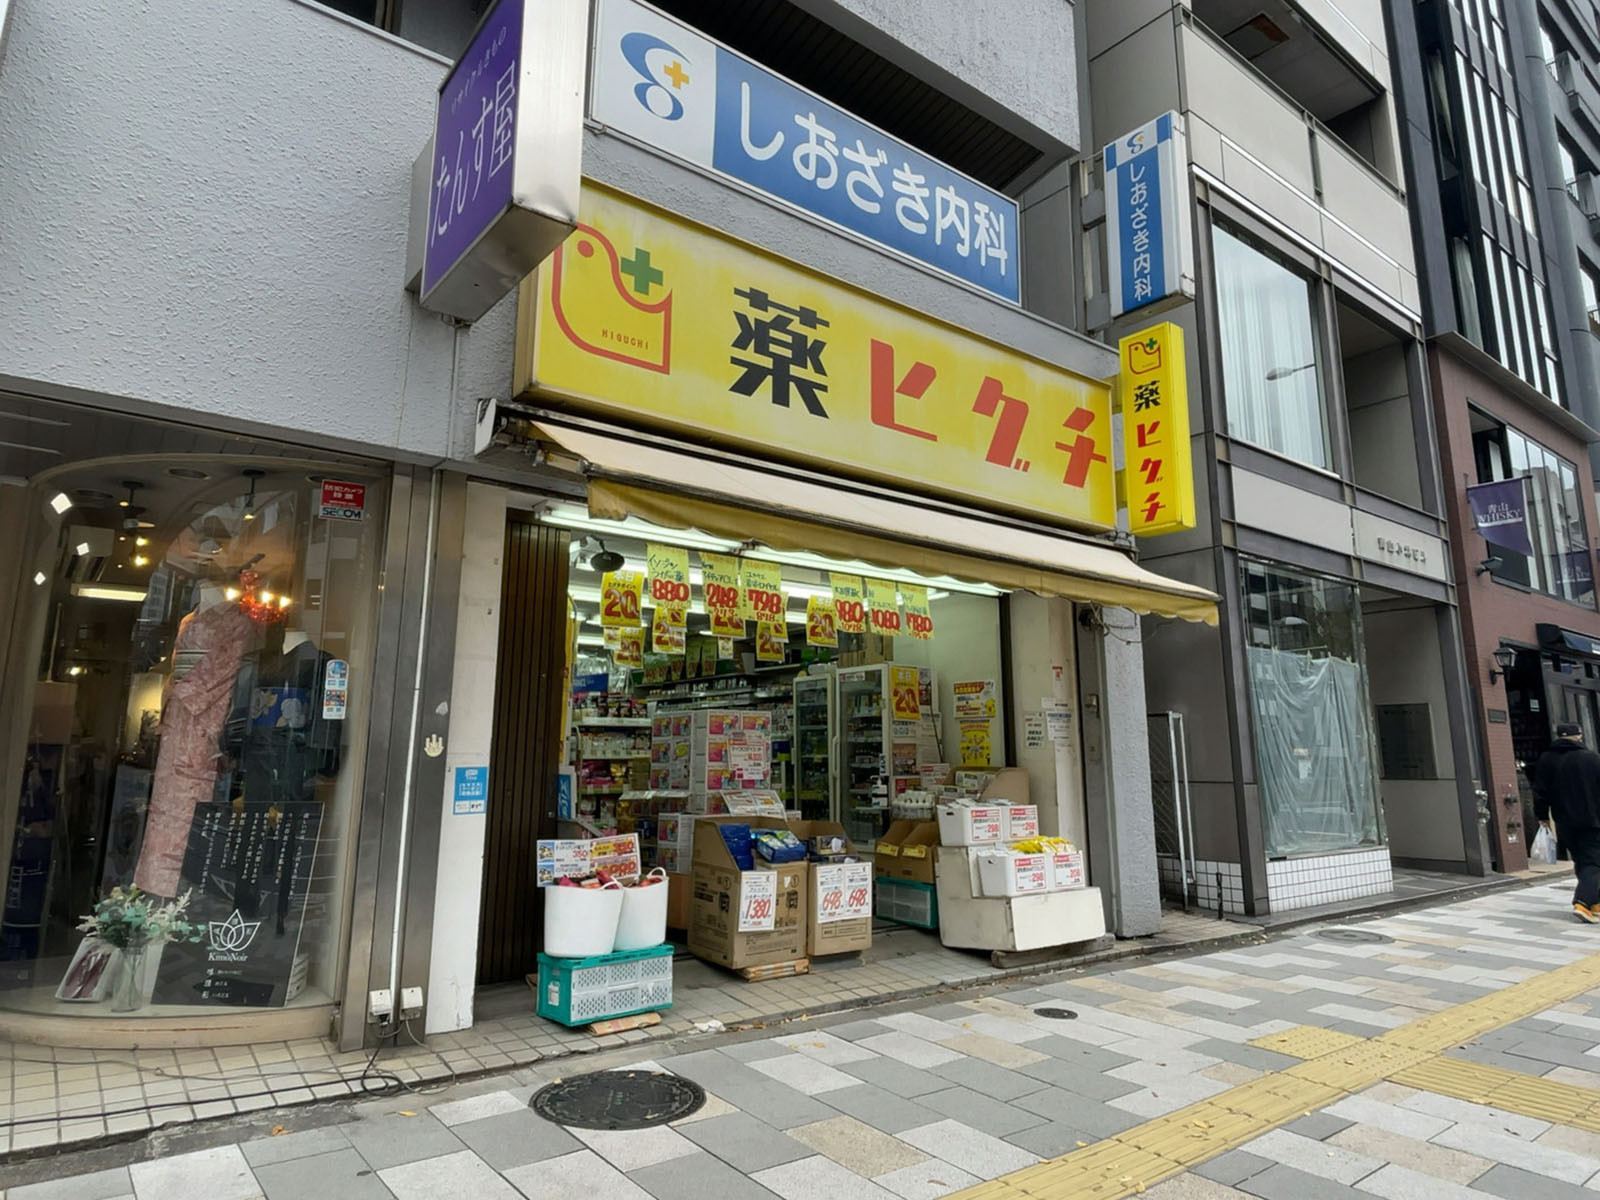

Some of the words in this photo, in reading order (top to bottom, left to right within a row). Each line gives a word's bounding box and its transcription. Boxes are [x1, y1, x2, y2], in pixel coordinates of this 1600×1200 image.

[431, 60, 515, 248] たんす屋
[740, 81, 1009, 276] しおざき内科
[1129, 162, 1152, 301] しおざき内科
[601, 327, 650, 351] HIGUCHI
[728, 286, 1108, 489] 薬ヒグチ
[1133, 379, 1167, 523] 薬ヒグチ
[322, 506, 361, 518] SECOM
[1476, 508, 1521, 523] WHISKY
[652, 578, 690, 602] 880
[706, 583, 739, 609] 248
[748, 589, 782, 614] 798
[604, 589, 640, 619] 20
[809, 612, 836, 639] 20
[893, 687, 920, 714] 20
